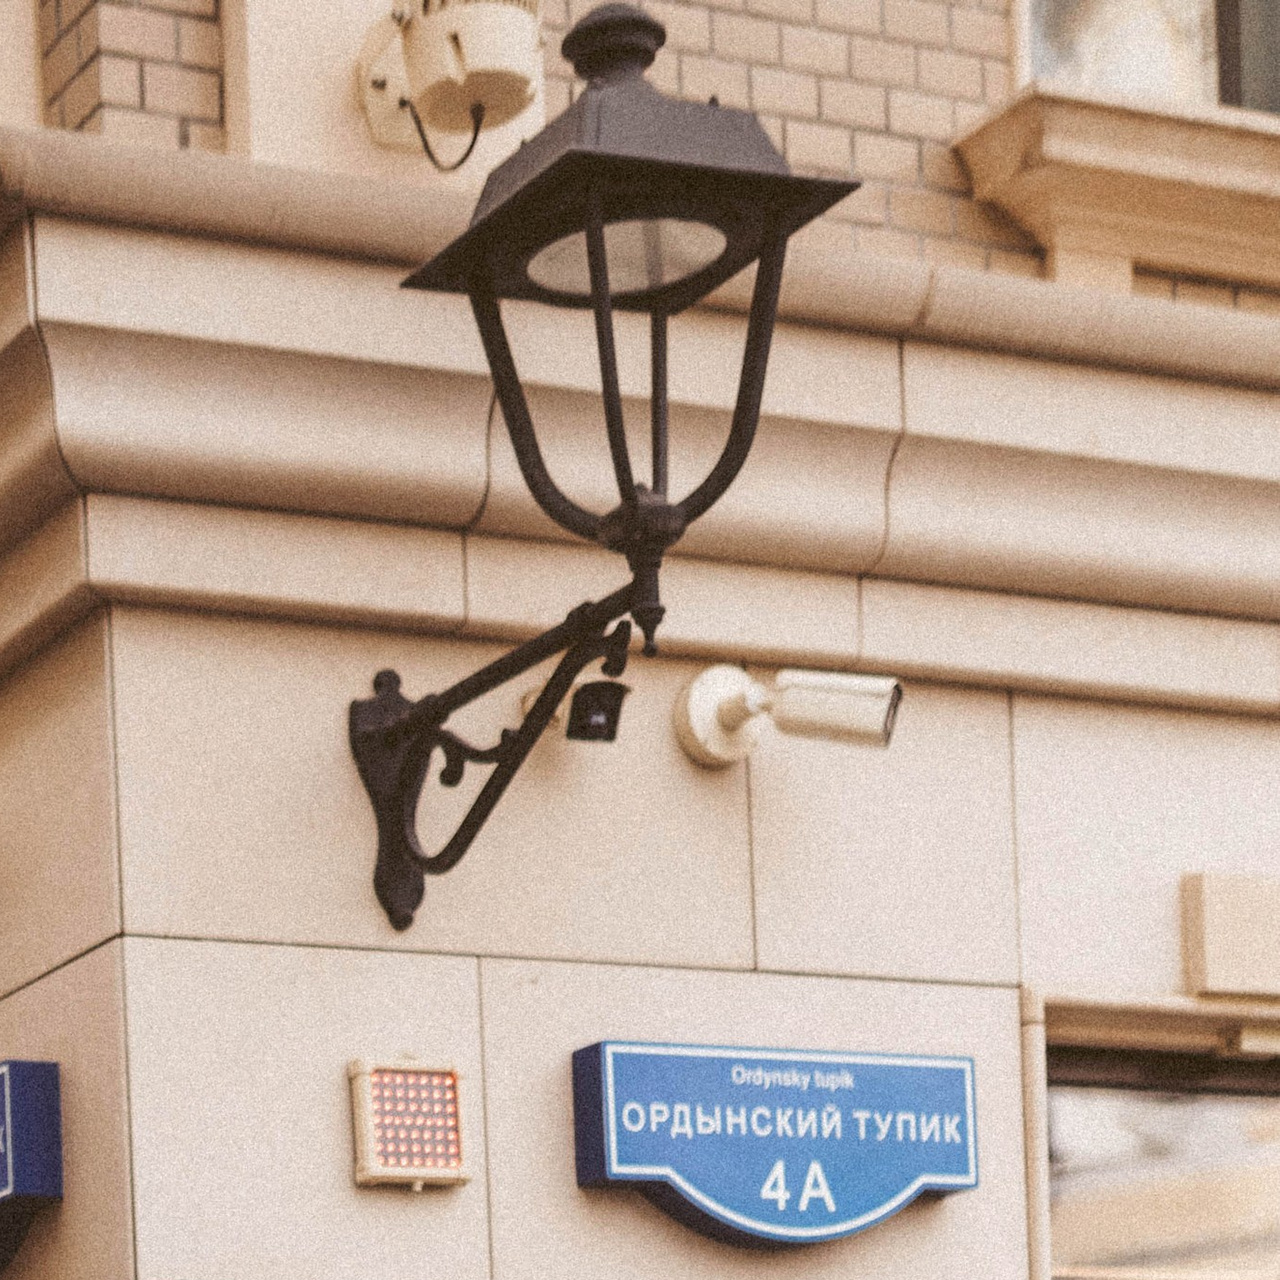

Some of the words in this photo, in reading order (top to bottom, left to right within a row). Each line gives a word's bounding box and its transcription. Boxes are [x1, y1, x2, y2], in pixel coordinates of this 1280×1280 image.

[621, 1102, 843, 1140] ОРДЫНСКИЙ
[852, 1110, 962, 1144] ТУПИК
[759, 1159, 837, 1213] 4А
